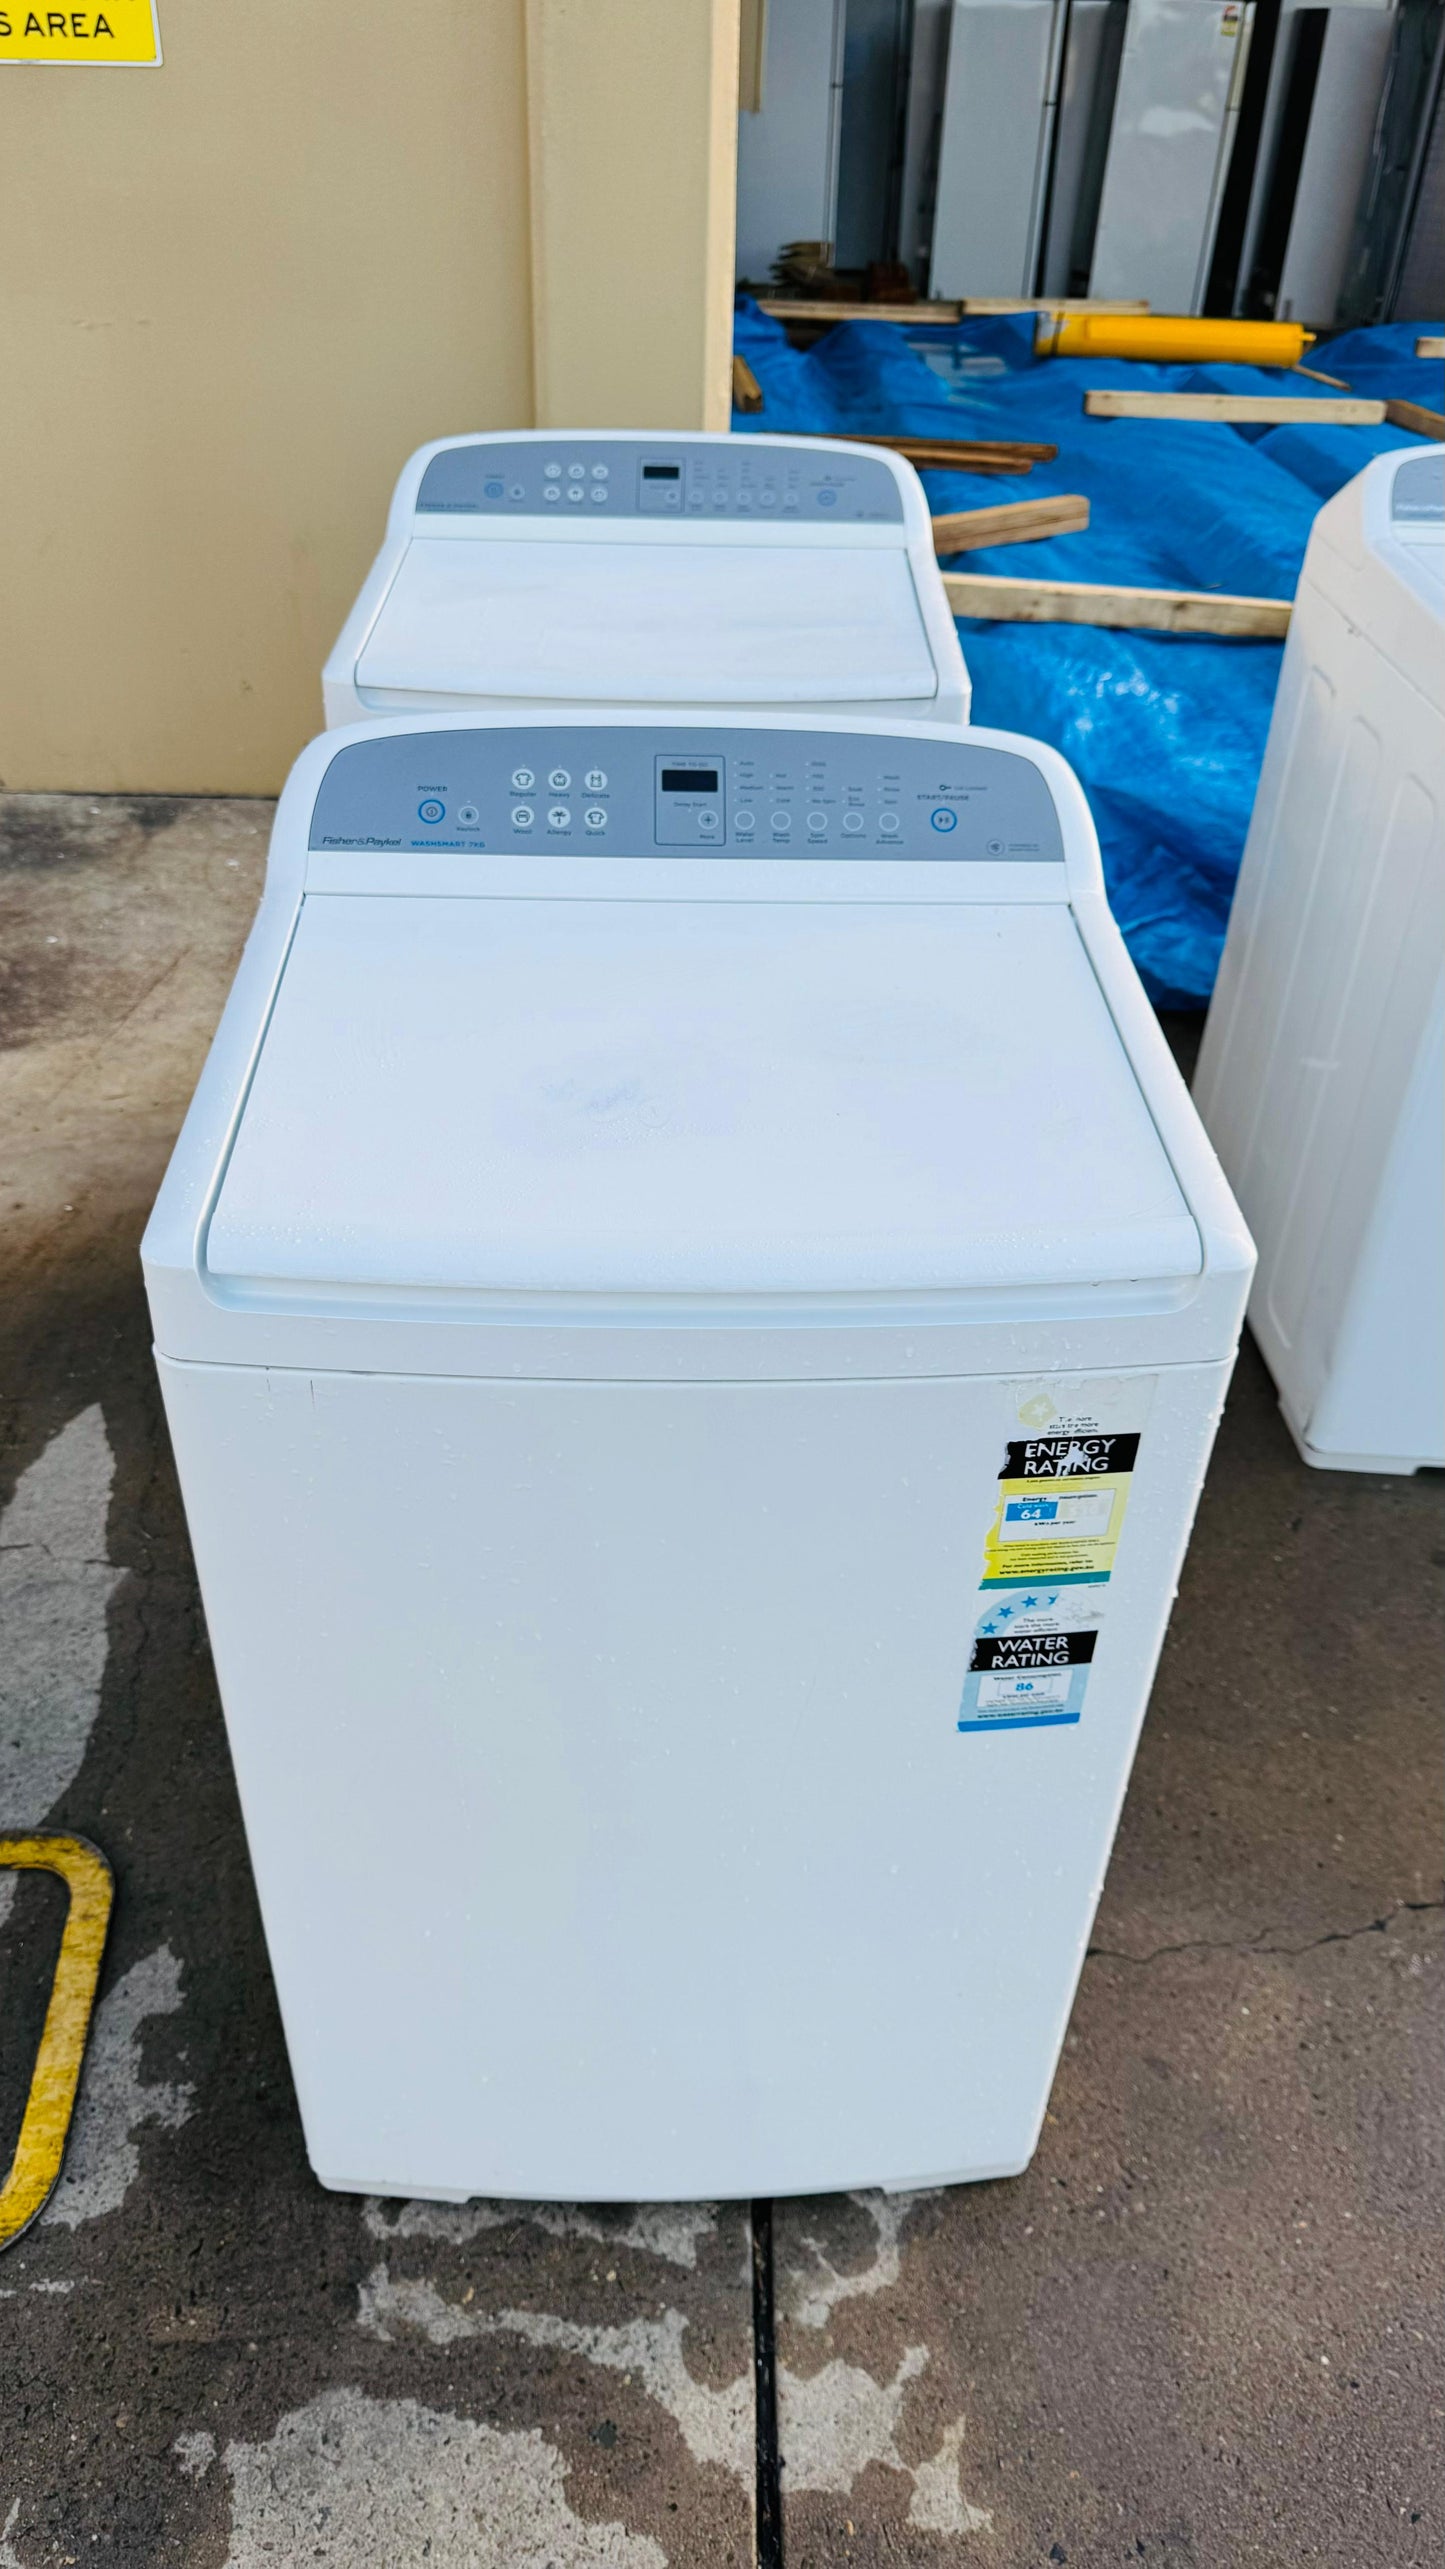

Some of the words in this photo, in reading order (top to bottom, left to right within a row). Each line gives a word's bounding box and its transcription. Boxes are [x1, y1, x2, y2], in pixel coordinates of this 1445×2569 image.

[24, 12, 115, 38] AREA
[411, 840, 466, 848] WASHSMART
[1024, 1438, 1117, 1458] ENERGY
[1020, 1508, 1042, 1519] 64
[998, 1636, 1069, 1653] WATER
[991, 1650, 1070, 1669] RATING
[1015, 1682, 1034, 1692] 86
